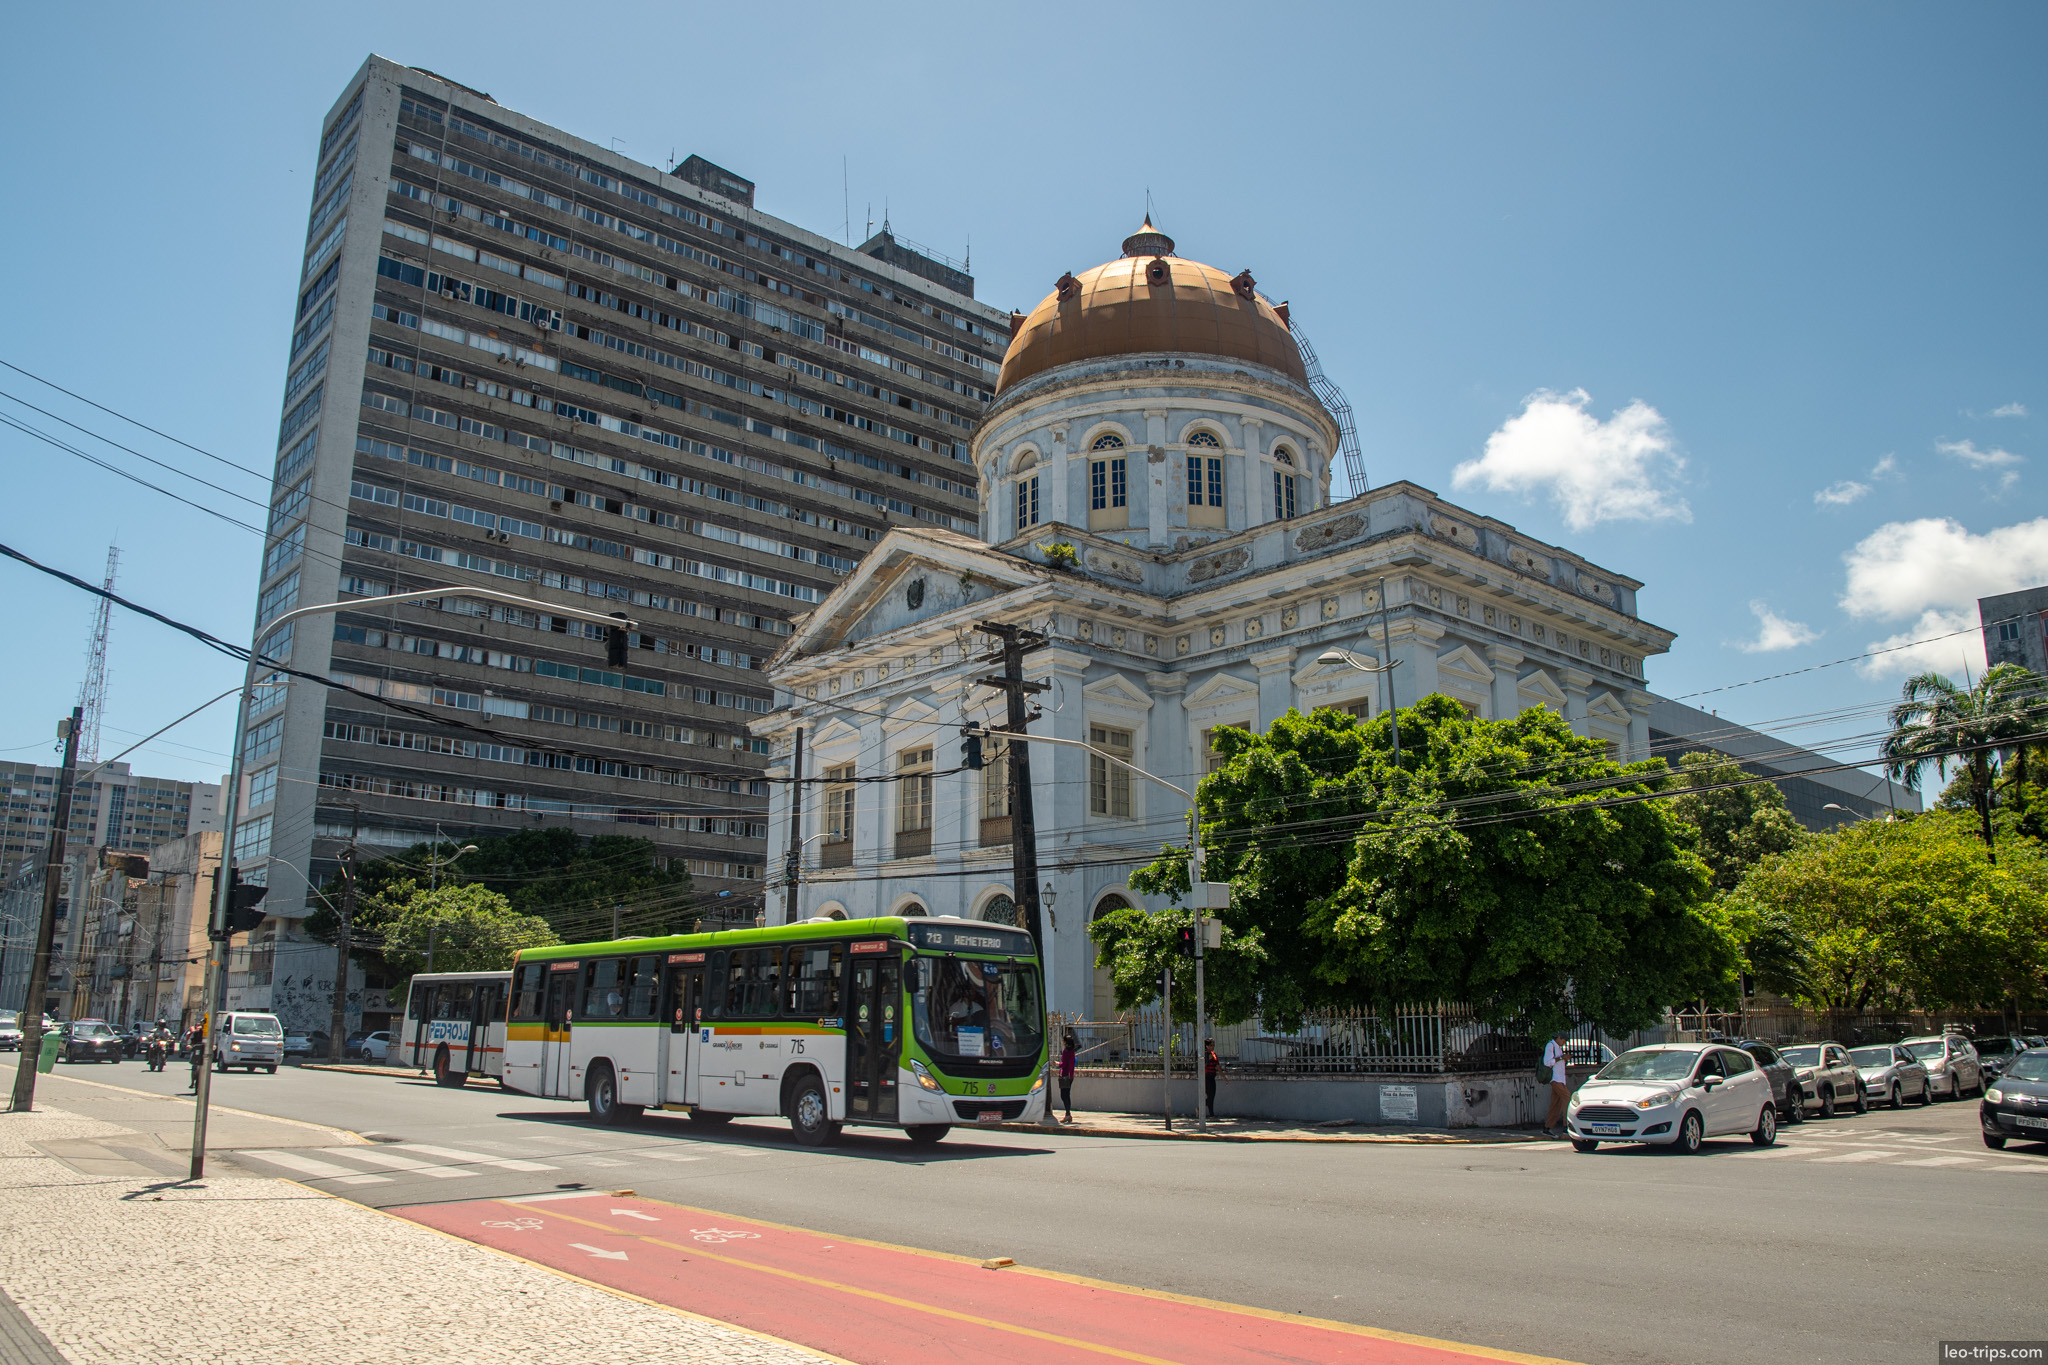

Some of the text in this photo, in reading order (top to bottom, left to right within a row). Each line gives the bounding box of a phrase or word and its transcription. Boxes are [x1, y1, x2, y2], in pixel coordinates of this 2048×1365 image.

[926, 933, 1001, 948] 713 HEMETERIO
[428, 1022, 469, 1041] PEDROSA
[790, 1039, 805, 1054] 715
[962, 1081, 979, 1094] 715
